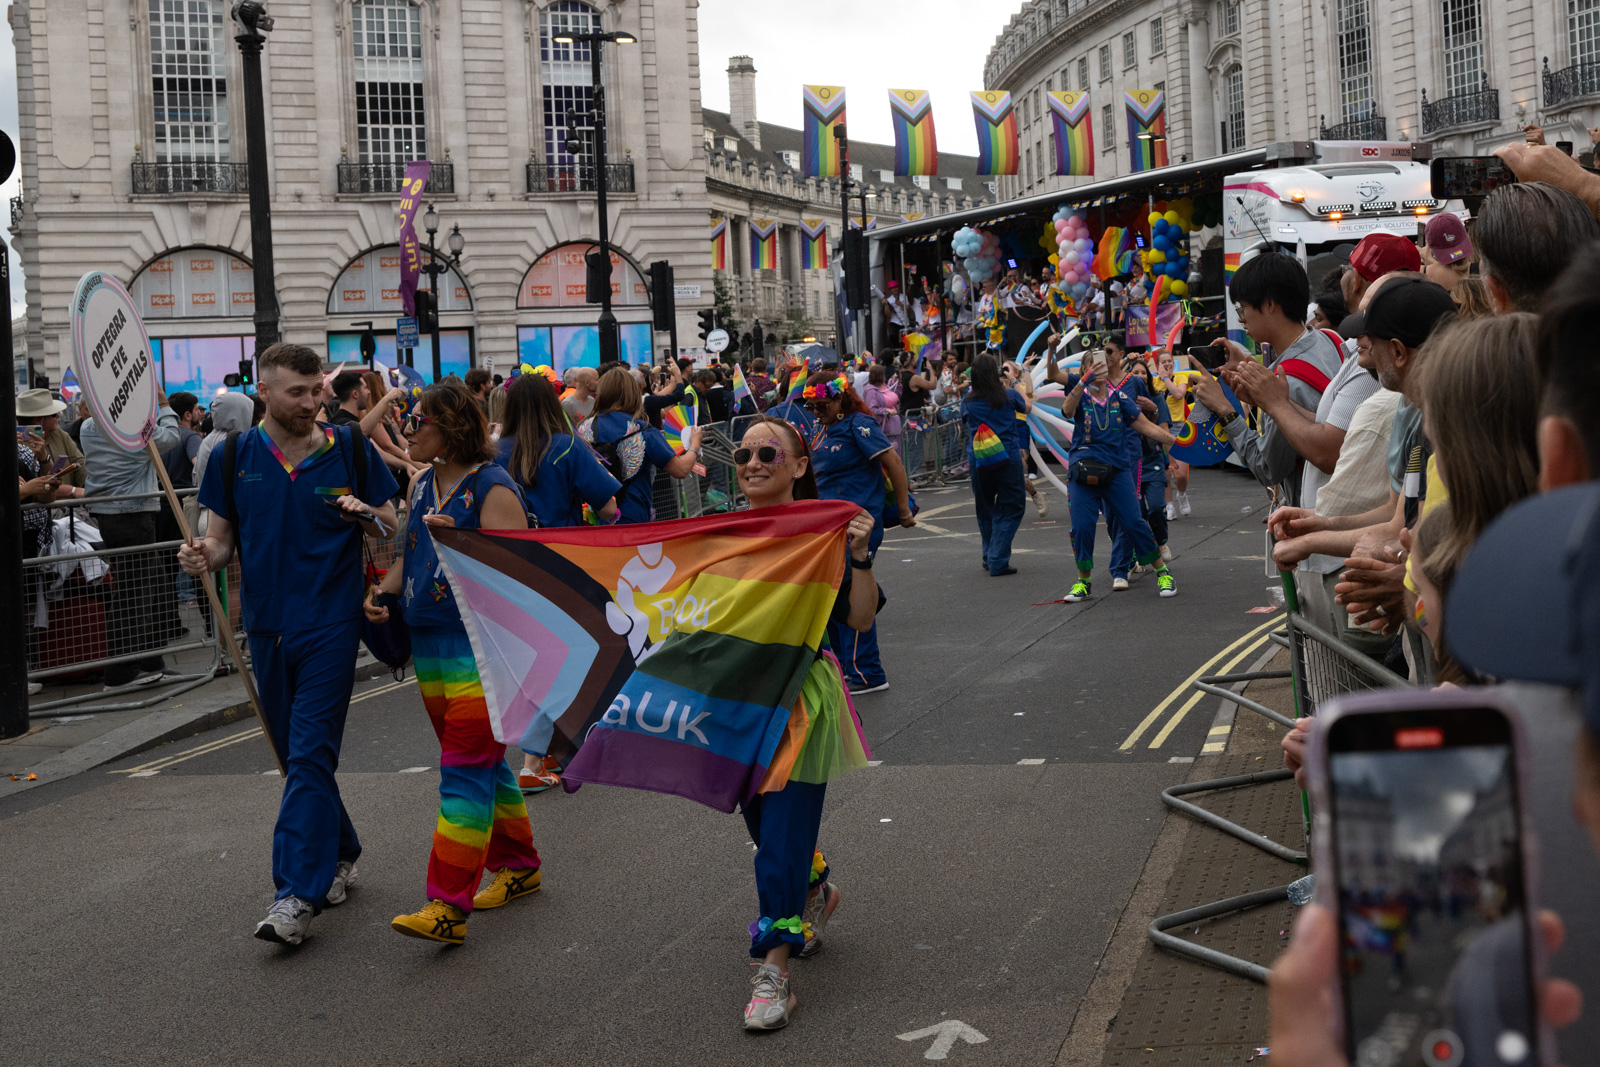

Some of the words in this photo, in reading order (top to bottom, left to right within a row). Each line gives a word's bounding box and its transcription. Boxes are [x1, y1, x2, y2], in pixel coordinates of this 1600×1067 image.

[1516, 113, 1569, 132] AIANC
[1362, 147, 1379, 156] SDC
[1384, 221, 1418, 229] SOLUTION
[91, 308, 127, 370] OPTEGRA
[110, 345, 129, 380] EYE
[108, 350, 149, 423] HOSPITALS
